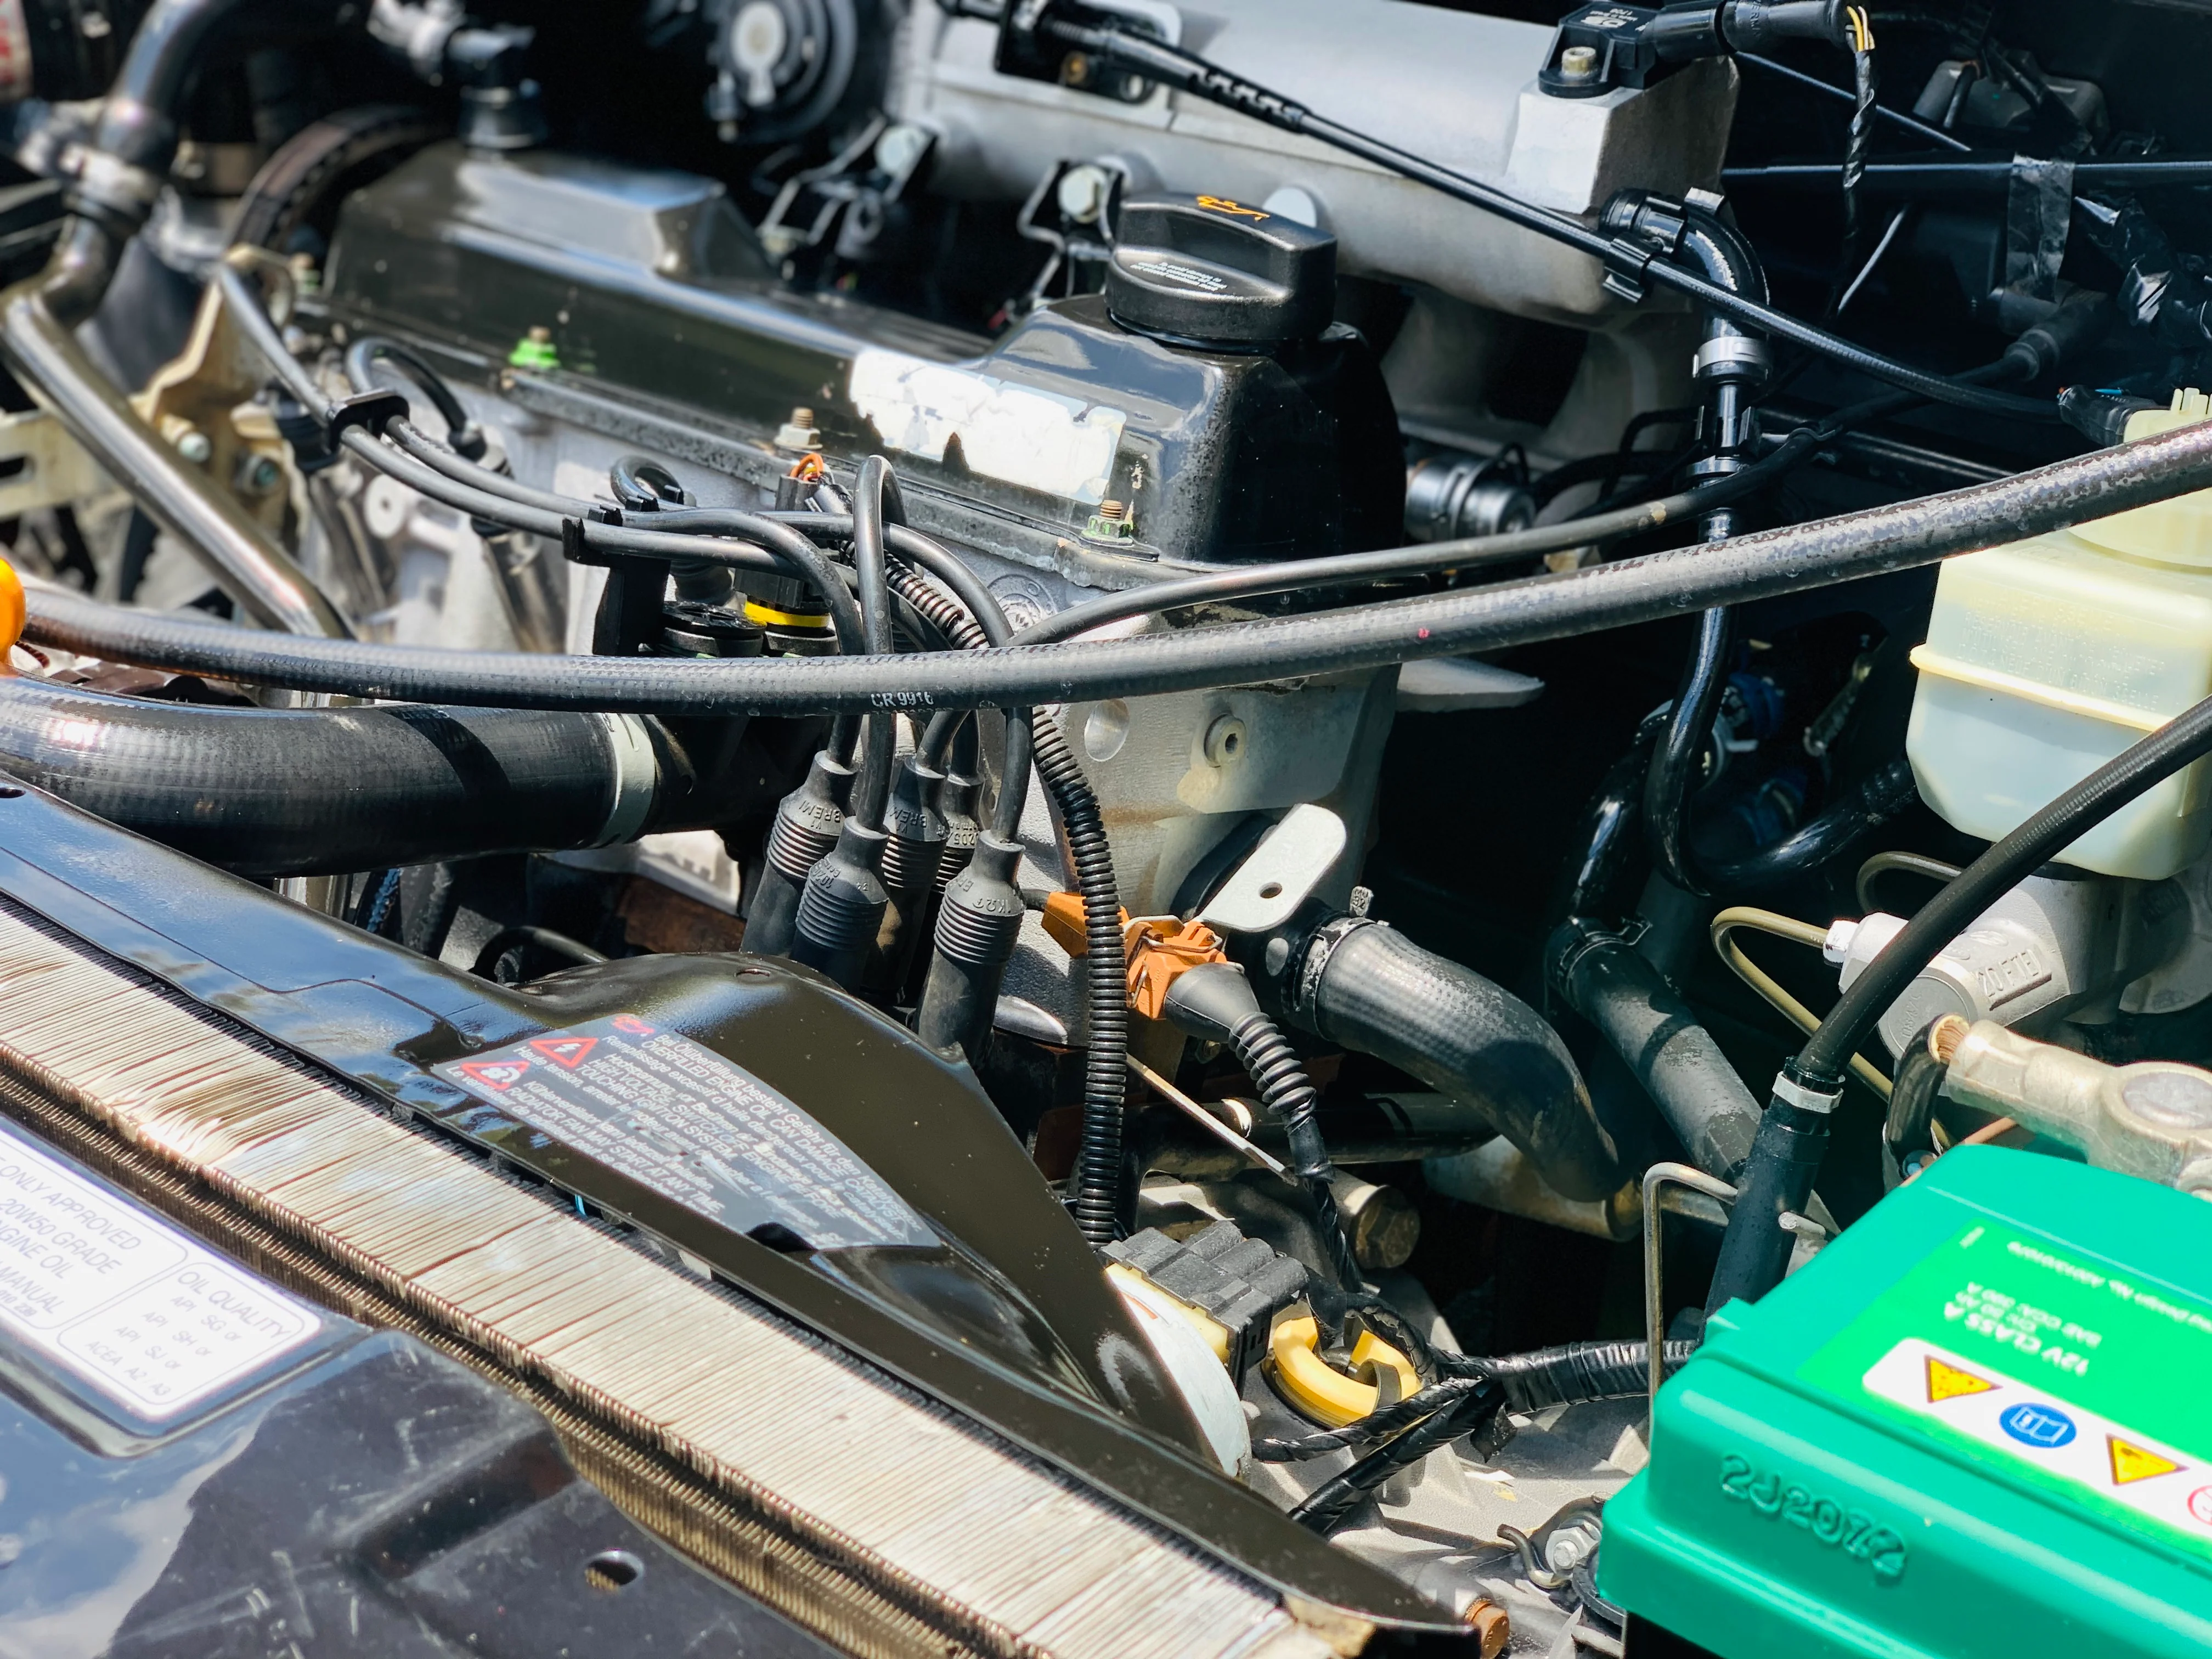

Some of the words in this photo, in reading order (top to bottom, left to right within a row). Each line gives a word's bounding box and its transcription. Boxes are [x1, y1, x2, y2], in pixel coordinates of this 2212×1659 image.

[871, 692, 896, 707] CR
[798, 798, 842, 823] BREMI
[444, 1065, 467, 1077] Le
[460, 1075, 519, 1108] ventilateur
[509, 1104, 533, 1116] de
[524, 1113, 578, 1141] radiateur
[512, 1045, 551, 1066] Haute
[614, 1103, 634, 1113] le
[627, 1109, 672, 1133] moteur
[662, 1131, 701, 1150] avant
[522, 1080, 605, 1125] Kühlerventilator
[595, 1121, 628, 1139] kann
[615, 1135, 673, 1163] jederzeit
[573, 1064, 640, 1099] TOUCHING
[631, 1096, 690, 1128] IGNITION
[681, 1125, 742, 1161] SYSTEM.
[600, 1034, 675, 1074] Remplissage
[667, 1070, 720, 1097] excessif
[799, 1161, 837, 1183] pour
[829, 1182, 850, 1192] le
[639, 1039, 712, 1078] OVERFILLED
[703, 1076, 755, 1106] ENGINE
[746, 1104, 775, 1120] OIL
[765, 1118, 802, 1138] CAN
[792, 1137, 851, 1177] DAMAGE
[842, 1177, 906, 1223] CATALYST.
[504, 1086, 568, 1121] RADIATOR
[558, 1117, 592, 1134] FAN
[582, 1130, 618, 1148] MAY
[606, 1144, 656, 1169] START
[644, 1165, 671, 1178] AT
[659, 1175, 697, 1194] ANY
[588, 1058, 624, 1077] HIGH
[669, 1103, 726, 1136] SWITCH
[716, 1132, 752, 1152] OFF
[741, 1150, 795, 1184] ENGINE
[786, 1182, 846, 1219] BEFORE
[653, 1034, 679, 1047] Bei
[671, 1042, 748, 1087] Ölüberfüllung
[740, 1084, 791, 1115] besteht
[781, 1113, 828, 1144] Gefahr
[819, 1142, 844, 1158] für
[833, 1156, 865, 1175] den
[855, 1175, 929, 1232] Katalysator.
[0, 1164, 50, 1195] ONLY
[41, 1189, 143, 1251] APPROVED
[0, 1198, 59, 1235] 20W50
[49, 1231, 121, 1274] GRADE
[0, 1267, 69, 1313] MANUAL
[38, 1254, 78, 1278] OIL
[140, 1311, 169, 1327] API
[171, 1331, 199, 1346] SH
[168, 1296, 197, 1312] API
[199, 1314, 228, 1331] SG
[175, 1271, 216, 1294] OIL
[206, 1289, 291, 1340] QUALITY
[1941, 1302, 1965, 1322] A
[1963, 1311, 2042, 1355] CLASS
[83, 1341, 125, 1365] ACEA
[114, 1326, 142, 1342] API
[143, 1345, 168, 1359] SJ
[2040, 1344, 2090, 1376] 12V
